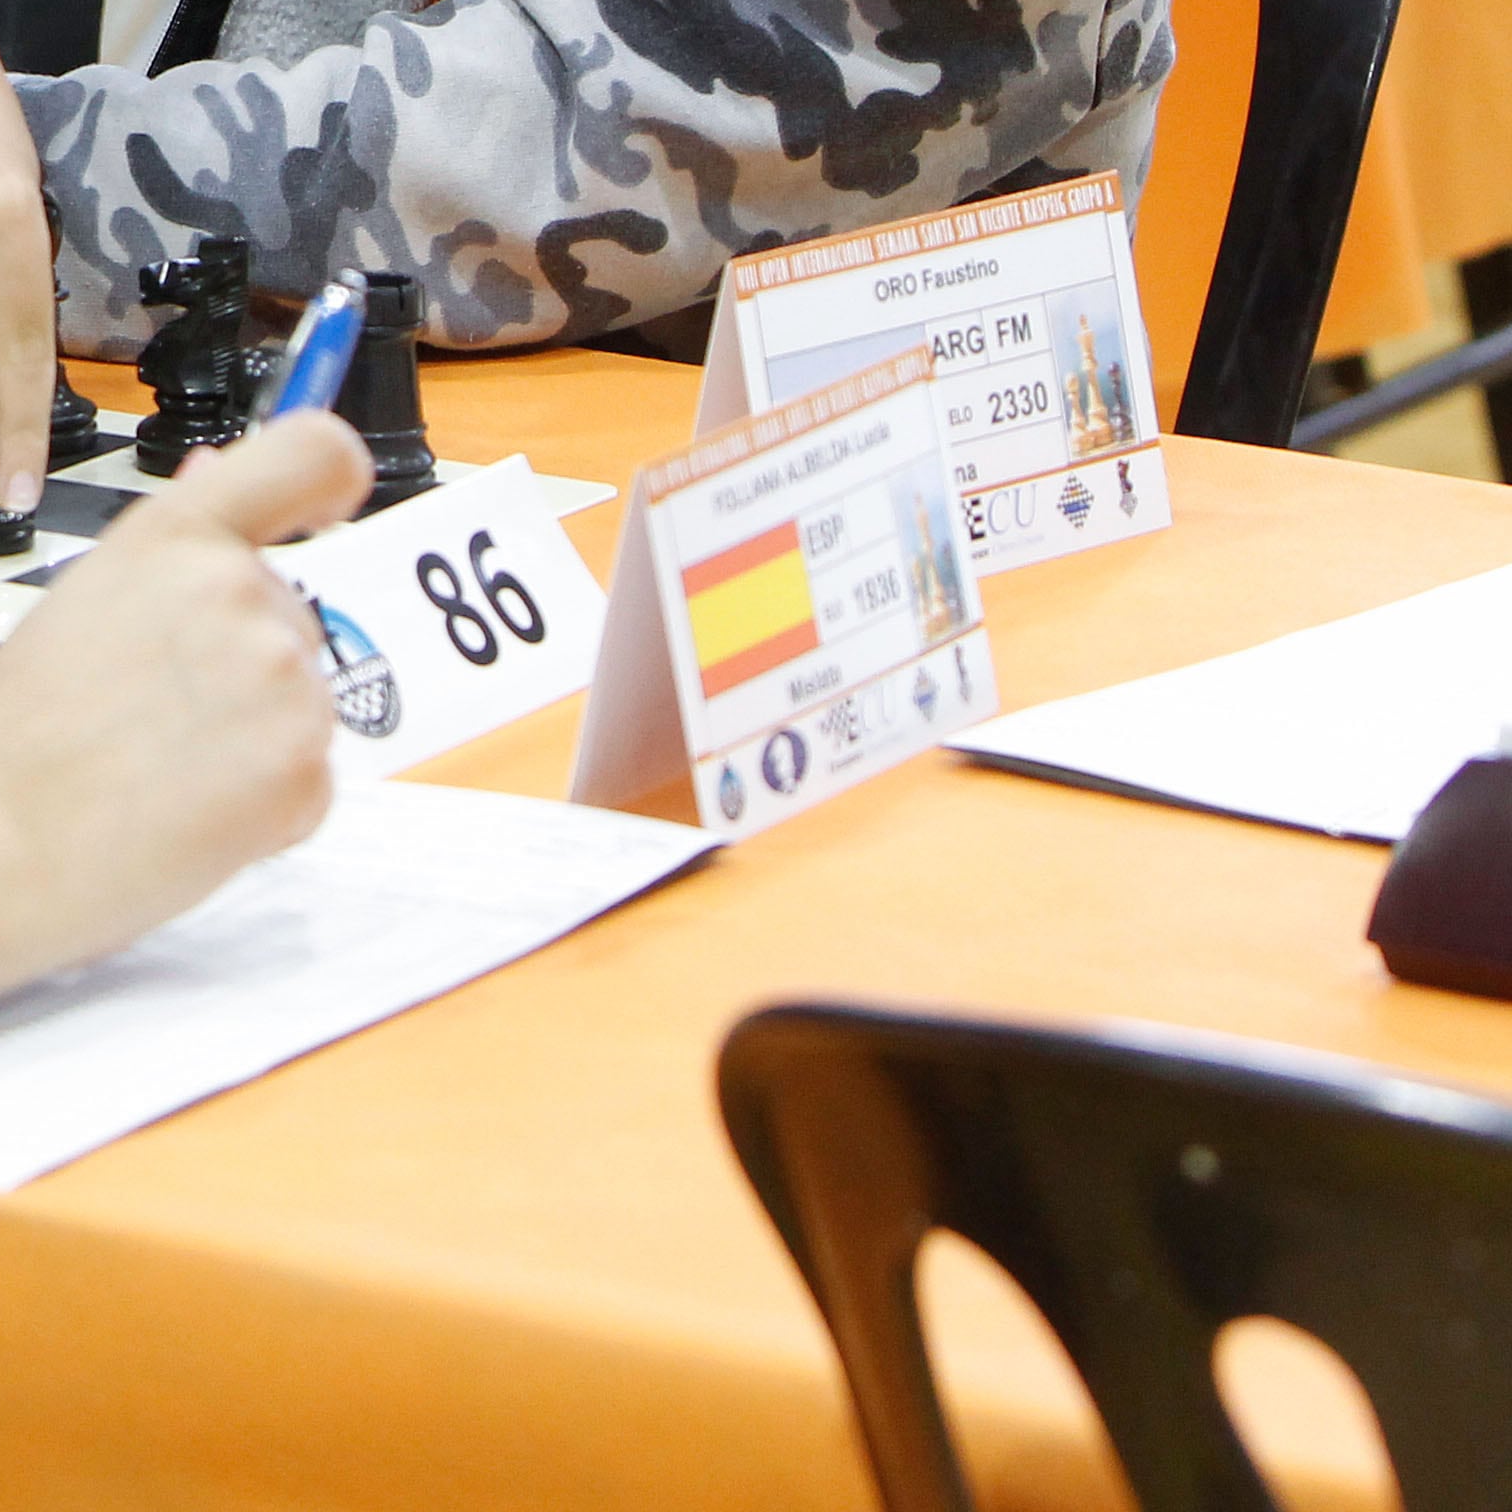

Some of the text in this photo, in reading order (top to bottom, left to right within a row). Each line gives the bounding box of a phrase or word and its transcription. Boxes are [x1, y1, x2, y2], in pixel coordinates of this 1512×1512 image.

[876, 224, 921, 261] SEMANA
[920, 217, 956, 248] SANTA
[956, 211, 979, 240] SAN
[979, 201, 1022, 234] VICENTE
[1021, 192, 1067, 224] RASPEIG
[1068, 182, 1103, 213] GRUPO
[1105, 178, 1116, 206] A
[875, 257, 999, 302] ORO Faustino
[933, 313, 1032, 362] ARG FM
[948, 381, 1049, 427] ELO 2330
[805, 512, 844, 558] ESP
[416, 529, 546, 667] 86
